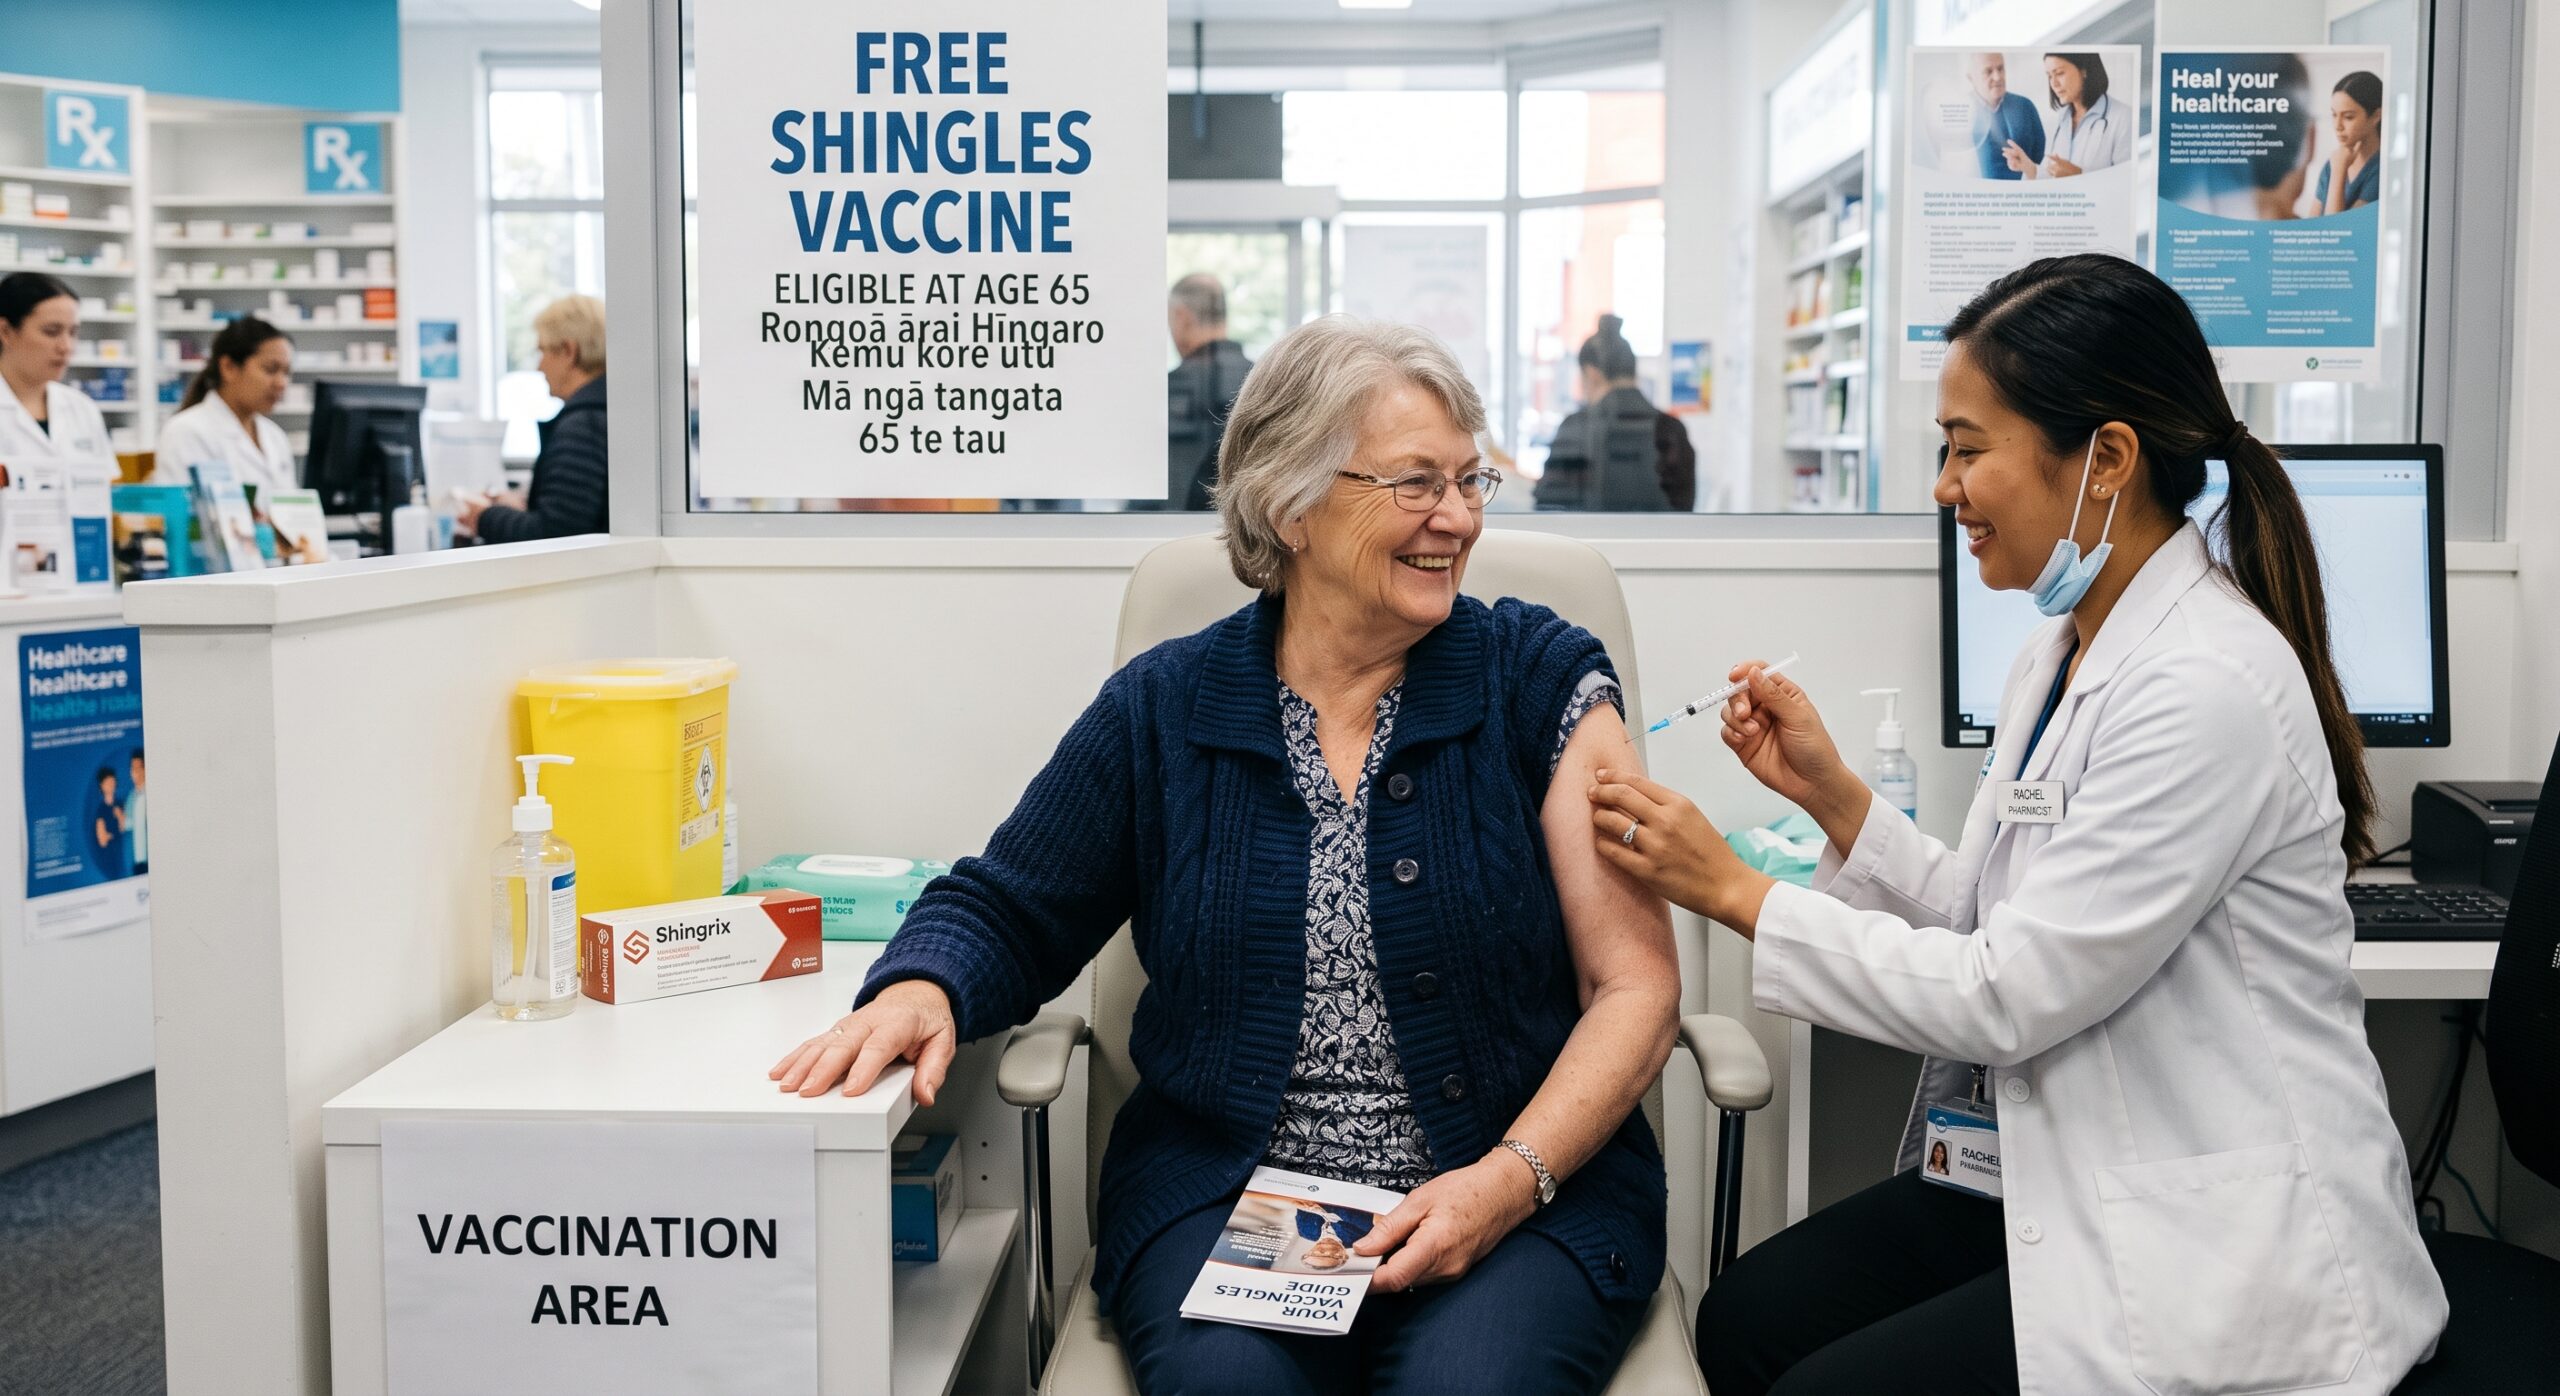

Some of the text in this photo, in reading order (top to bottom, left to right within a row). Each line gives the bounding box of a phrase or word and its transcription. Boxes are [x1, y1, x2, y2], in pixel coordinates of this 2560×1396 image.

[856, 31, 1009, 95] FREE
[2172, 67, 2280, 96] Heal your
[2171, 91, 2290, 114] healthcare
[770, 109, 1092, 175] SHINGLES
[788, 189, 1073, 255] VACCINE
[775, 273, 1090, 306] ELIGIBLE AT AGE 65
[898, 311, 960, 344] ārai
[917, 337, 989, 369] kore
[1001, 340, 1054, 369] utu
[803, 380, 1062, 421] Mā ngā tangata
[859, 423, 1005, 454] 65 te tau
[28, 643, 127, 671] Healthcare
[29, 669, 128, 697] healthcare
[2013, 788, 2045, 801] RACHEL
[656, 918, 731, 944] Shingrix
[1961, 1147, 2002, 1168] RACHEL
[417, 1213, 778, 1260] VACCINATION
[1214, 1284, 1344, 1309] VACCINGLES
[1286, 1281, 1350, 1297] GUIDE
[530, 1284, 670, 1328] AREA
[1282, 1306, 1339, 1321] YOUR
